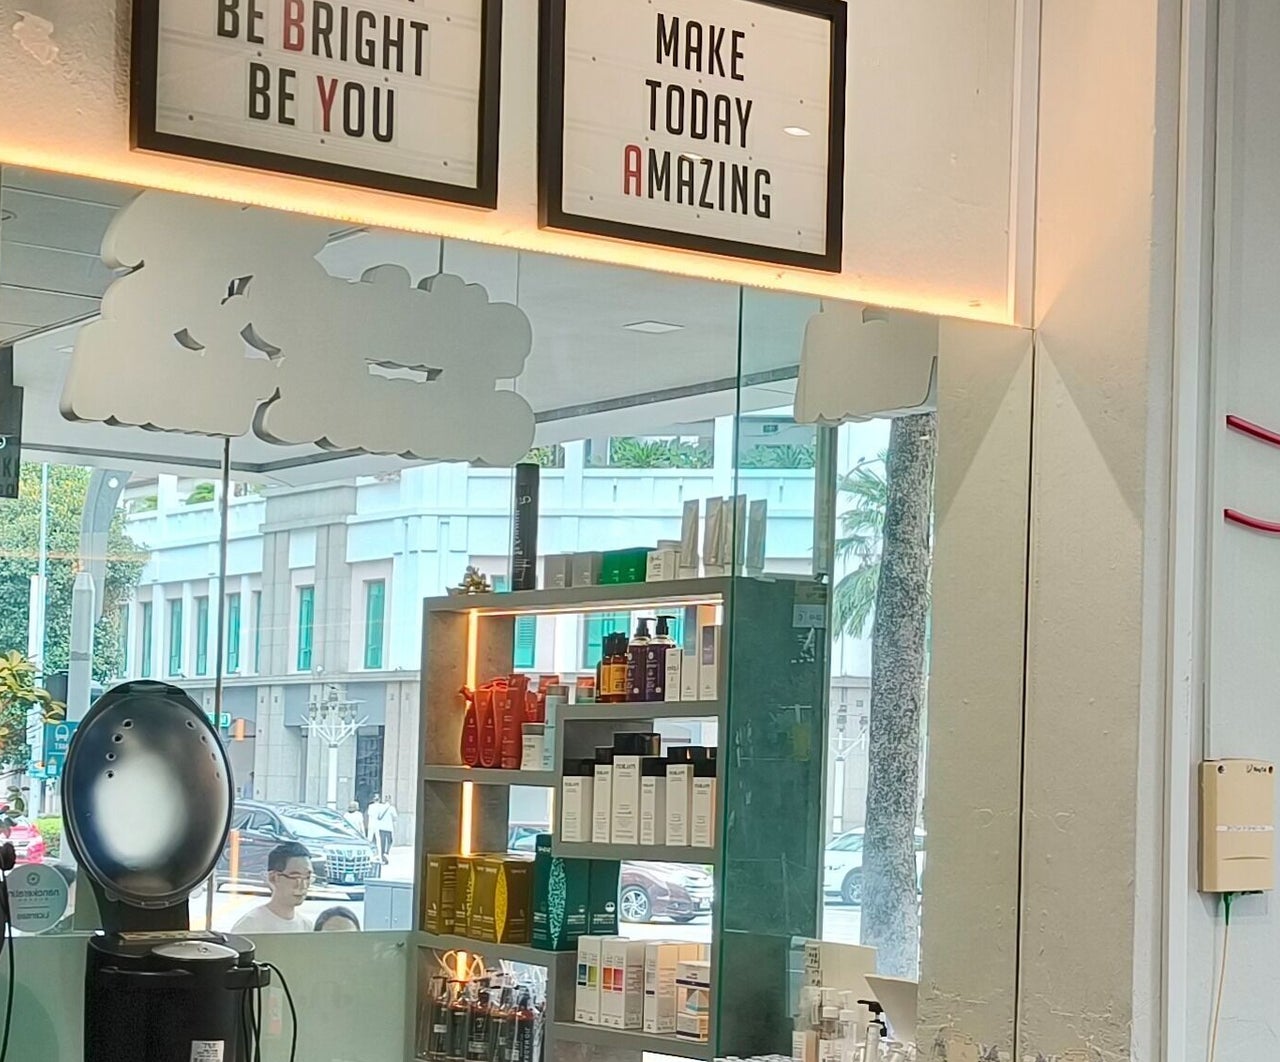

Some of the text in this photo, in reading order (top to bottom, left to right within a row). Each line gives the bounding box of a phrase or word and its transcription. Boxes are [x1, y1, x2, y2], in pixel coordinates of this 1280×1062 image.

[282, 0, 429, 77] BRIGHT
[656, 13, 745, 81] MAKE
[248, 63, 395, 144] BE YOU
[646, 79, 752, 148] TODAY
[624, 144, 771, 219] AMAZING
